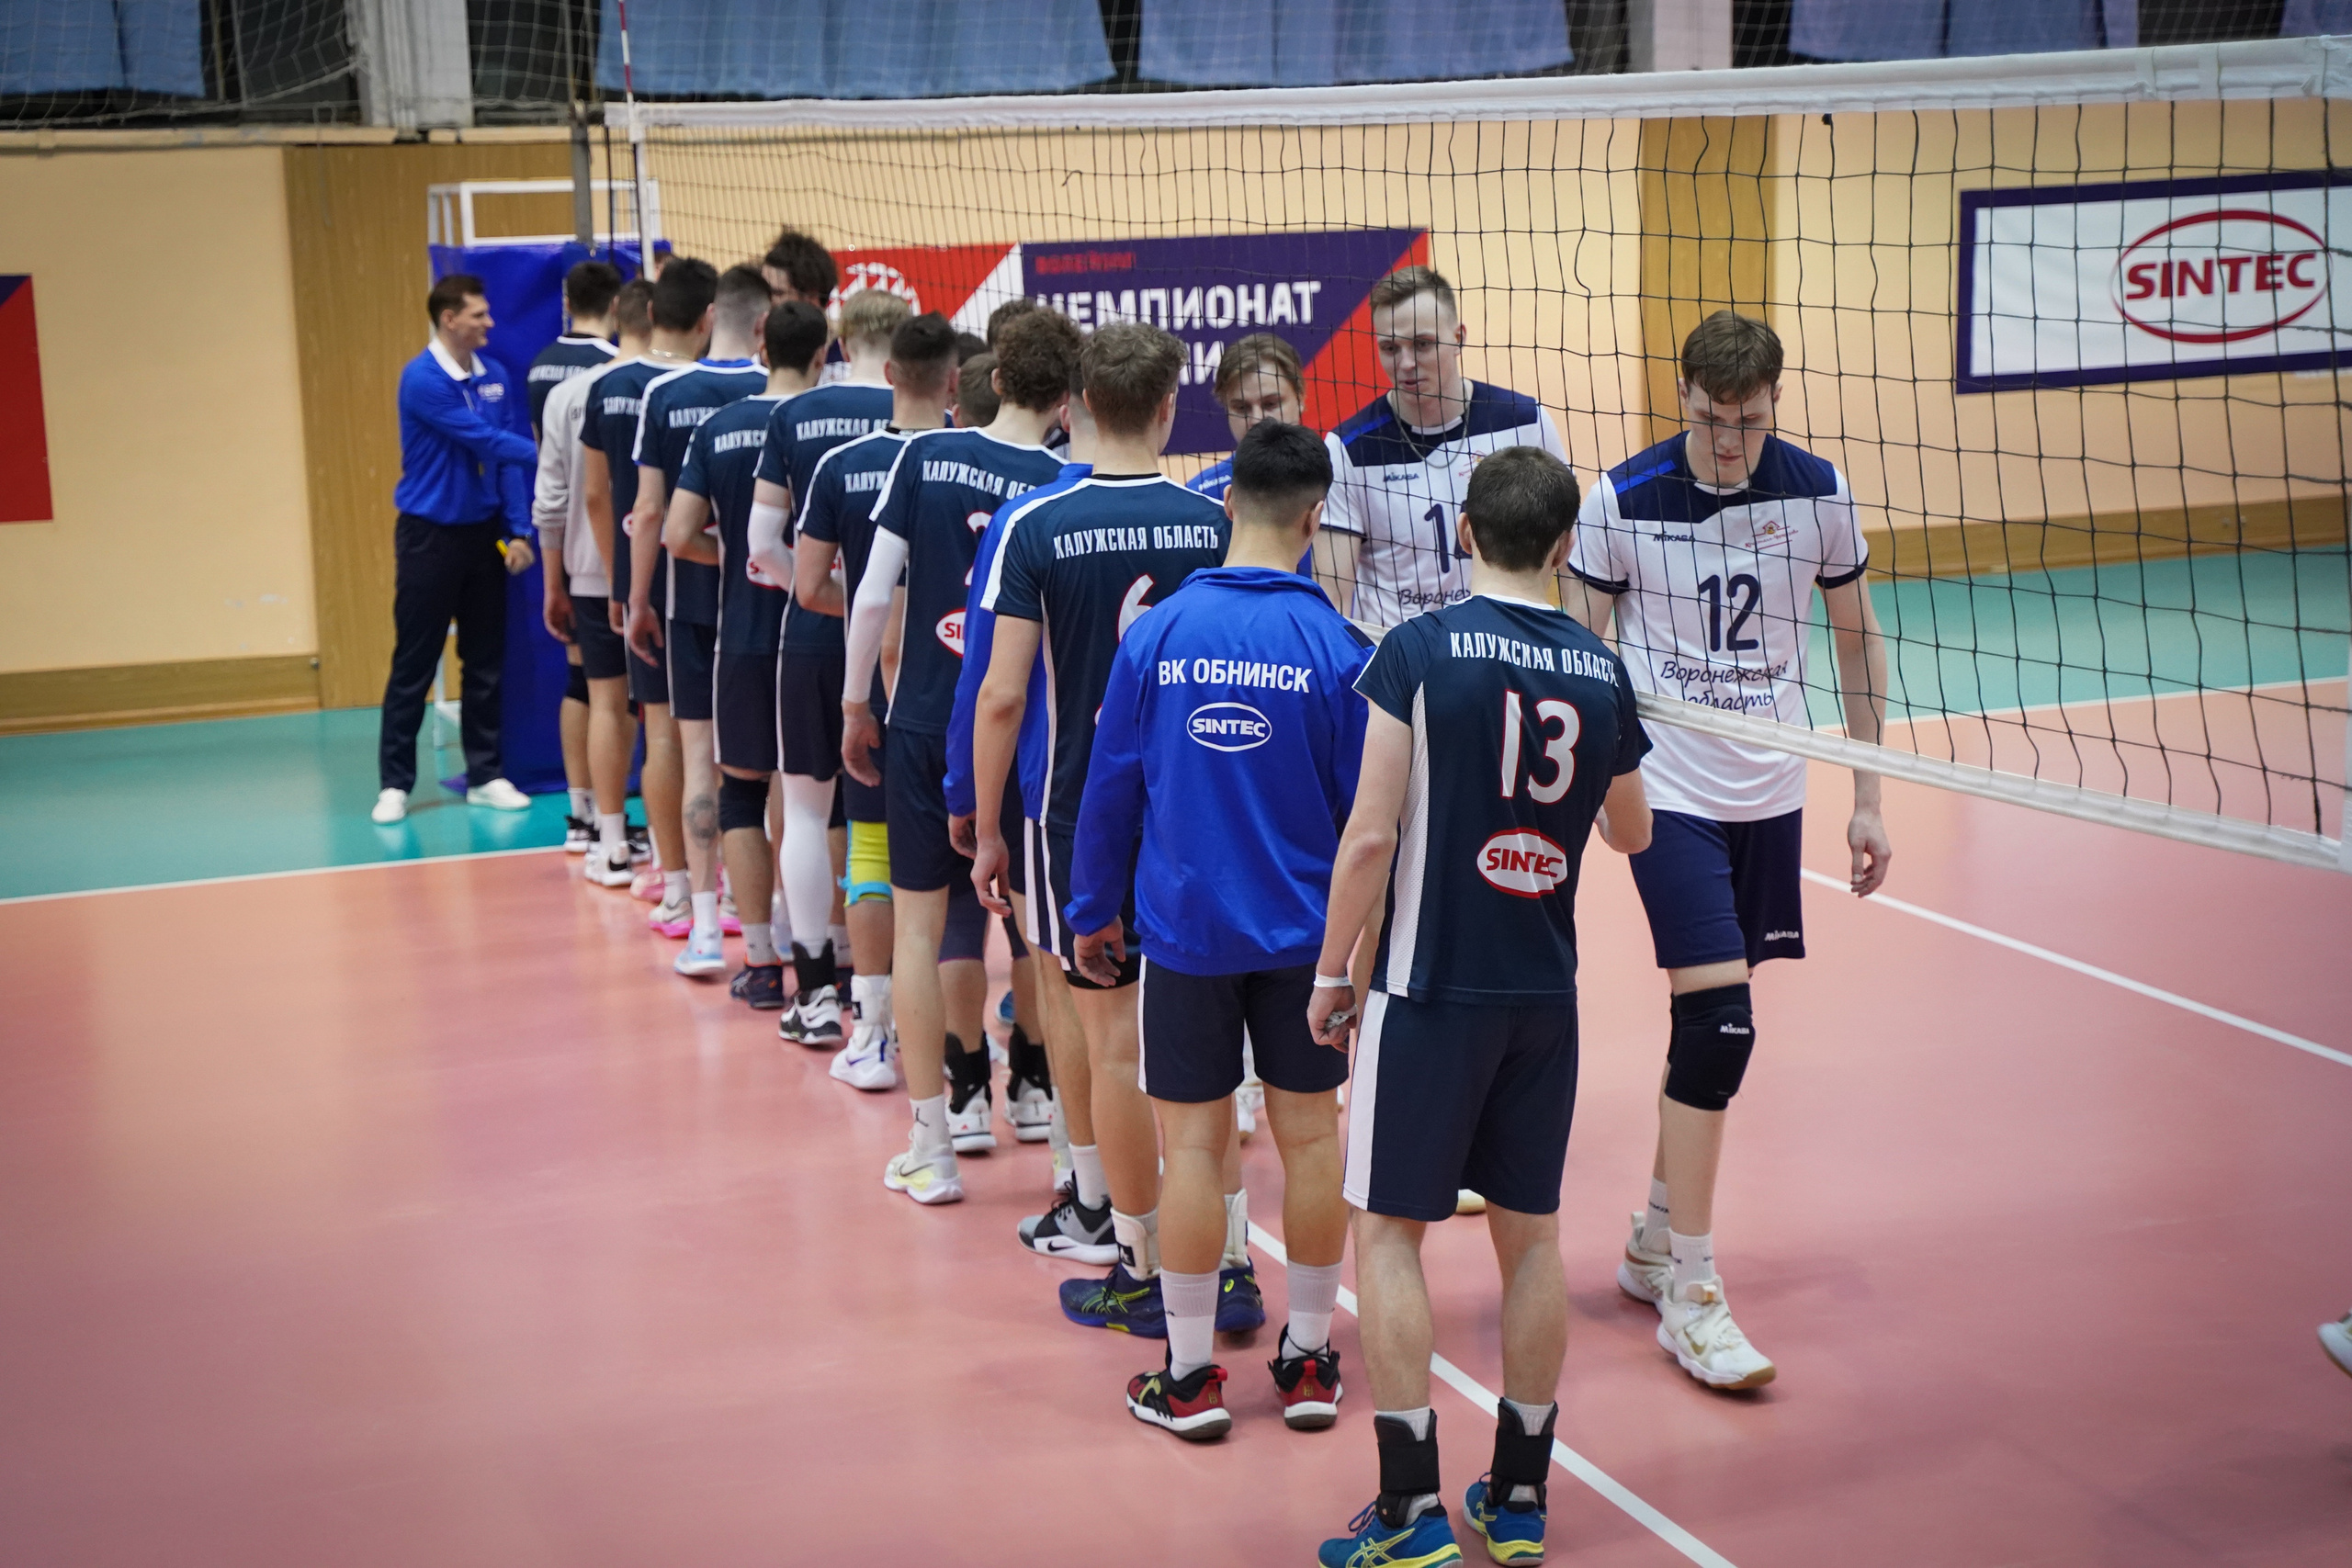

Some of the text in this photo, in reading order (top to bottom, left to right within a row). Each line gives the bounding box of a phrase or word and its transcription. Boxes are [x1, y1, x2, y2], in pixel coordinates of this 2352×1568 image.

[2126, 253, 2315, 300] SINTEC
[796, 417, 870, 442] КАЛУЖСКАЯ
[922, 459, 1005, 497] КАЛУЖСКАЯ
[1053, 525, 1219, 559] КАЛУЖСКАЯ ОБЛАСТЬ
[1699, 573, 1760, 652] 12
[944, 622, 966, 639] SI
[1450, 631, 1555, 672] КАЛУЖСКАЯ
[1158, 658, 1313, 694] ВК ОБНИНСК
[1660, 660, 1789, 688] Воронежская
[1193, 717, 1267, 738] SINTEC
[1500, 688, 1582, 805] 13
[1486, 847, 1564, 878] SINTEC
